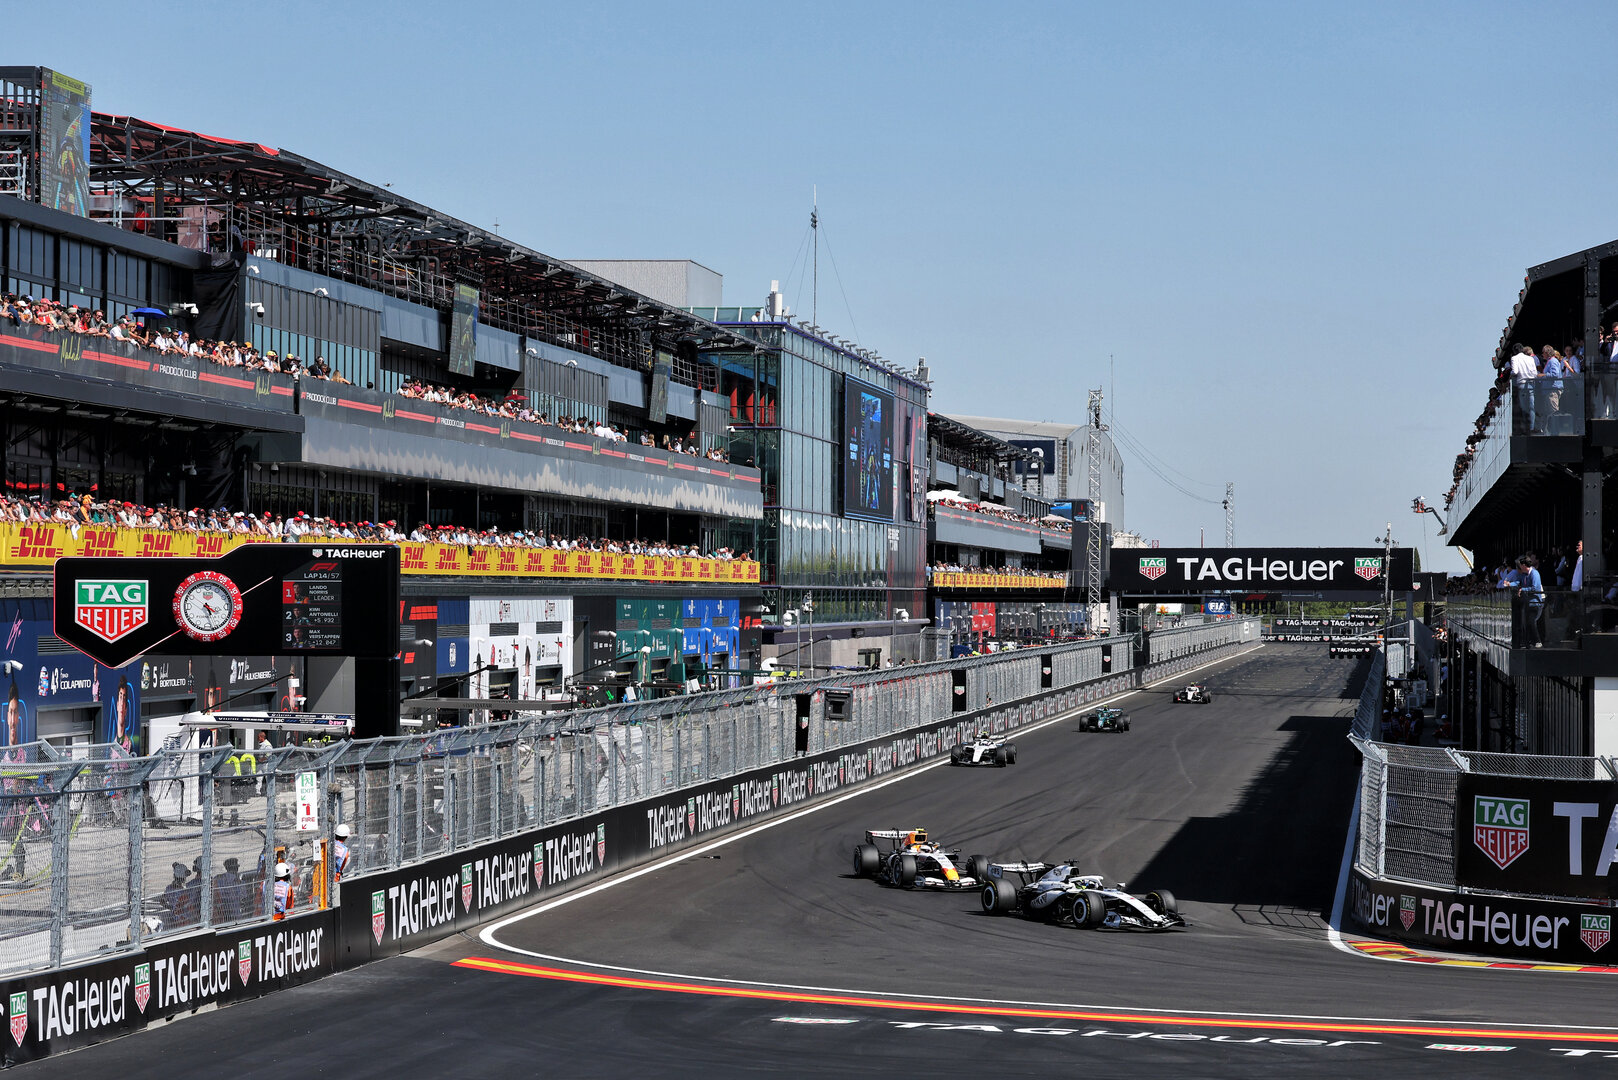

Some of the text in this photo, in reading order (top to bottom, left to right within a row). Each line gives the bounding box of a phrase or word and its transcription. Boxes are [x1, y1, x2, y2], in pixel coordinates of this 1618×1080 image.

[160, 364, 183, 378] PADDOCK
[184, 370, 197, 380] CLUB
[306, 392, 326, 403] PADDOCK
[326, 397, 336, 406] CLUB
[18, 528, 56, 558] DHL
[83, 530, 118, 558] DHL
[142, 534, 173, 558] DHL
[196, 536, 223, 558] DHL
[326, 549, 386, 558] TAGHeuer
[404, 546, 424, 568] DHL
[438, 548, 457, 570] DHL
[470, 550, 488, 572] DHL
[499, 551, 516, 572] DHL
[526, 552, 542, 572] DHL
[552, 554, 568, 573] DHL
[577, 554, 592, 574] DHL
[600, 556, 614, 574] DHL
[1141, 558, 1164, 568] TAG
[1140, 568, 1166, 578] HEUER
[1177, 557, 1344, 581] TAGHeuer
[81, 584, 142, 604] TAG
[286, 589, 292, 598] 1
[286, 612, 292, 620] 2
[1208, 602, 1225, 610] FIA
[80, 608, 144, 640] HEUER
[286, 633, 292, 642] 3
[152, 666, 158, 688] 5
[238, 662, 244, 680] 27
[60, 680, 92, 690] COLAPINTO
[160, 678, 186, 688] BORTOLETO
[778, 770, 807, 806] TAGHeuer
[813, 762, 838, 794] TAGHeuer
[740, 780, 772, 818] TAGHeuer
[696, 791, 732, 832] TAGHeuer
[1479, 801, 1524, 826] TAG
[647, 805, 686, 849] TAGHeuer
[1476, 829, 1526, 864] HEUER
[546, 832, 596, 885] TAGHeuer
[476, 850, 532, 909] TAGHeuer
[372, 893, 384, 914] TAG
[388, 872, 459, 941] TAGHeuer
[1402, 897, 1415, 909] TAG
[1421, 898, 1570, 950] TAGHeuer
[1582, 916, 1608, 929] TAG
[240, 942, 252, 958] TAG
[1582, 930, 1610, 949] HEUER
[255, 926, 324, 982] TAGHeuer
[136, 966, 150, 985] TAG
[154, 948, 235, 1008] TAGHeuer
[10, 996, 26, 1014] TAG
[33, 974, 130, 1042] TAGHeuer
[10, 1016, 28, 1044] HEUER
[888, 1021, 1383, 1047] TAGHeuer
